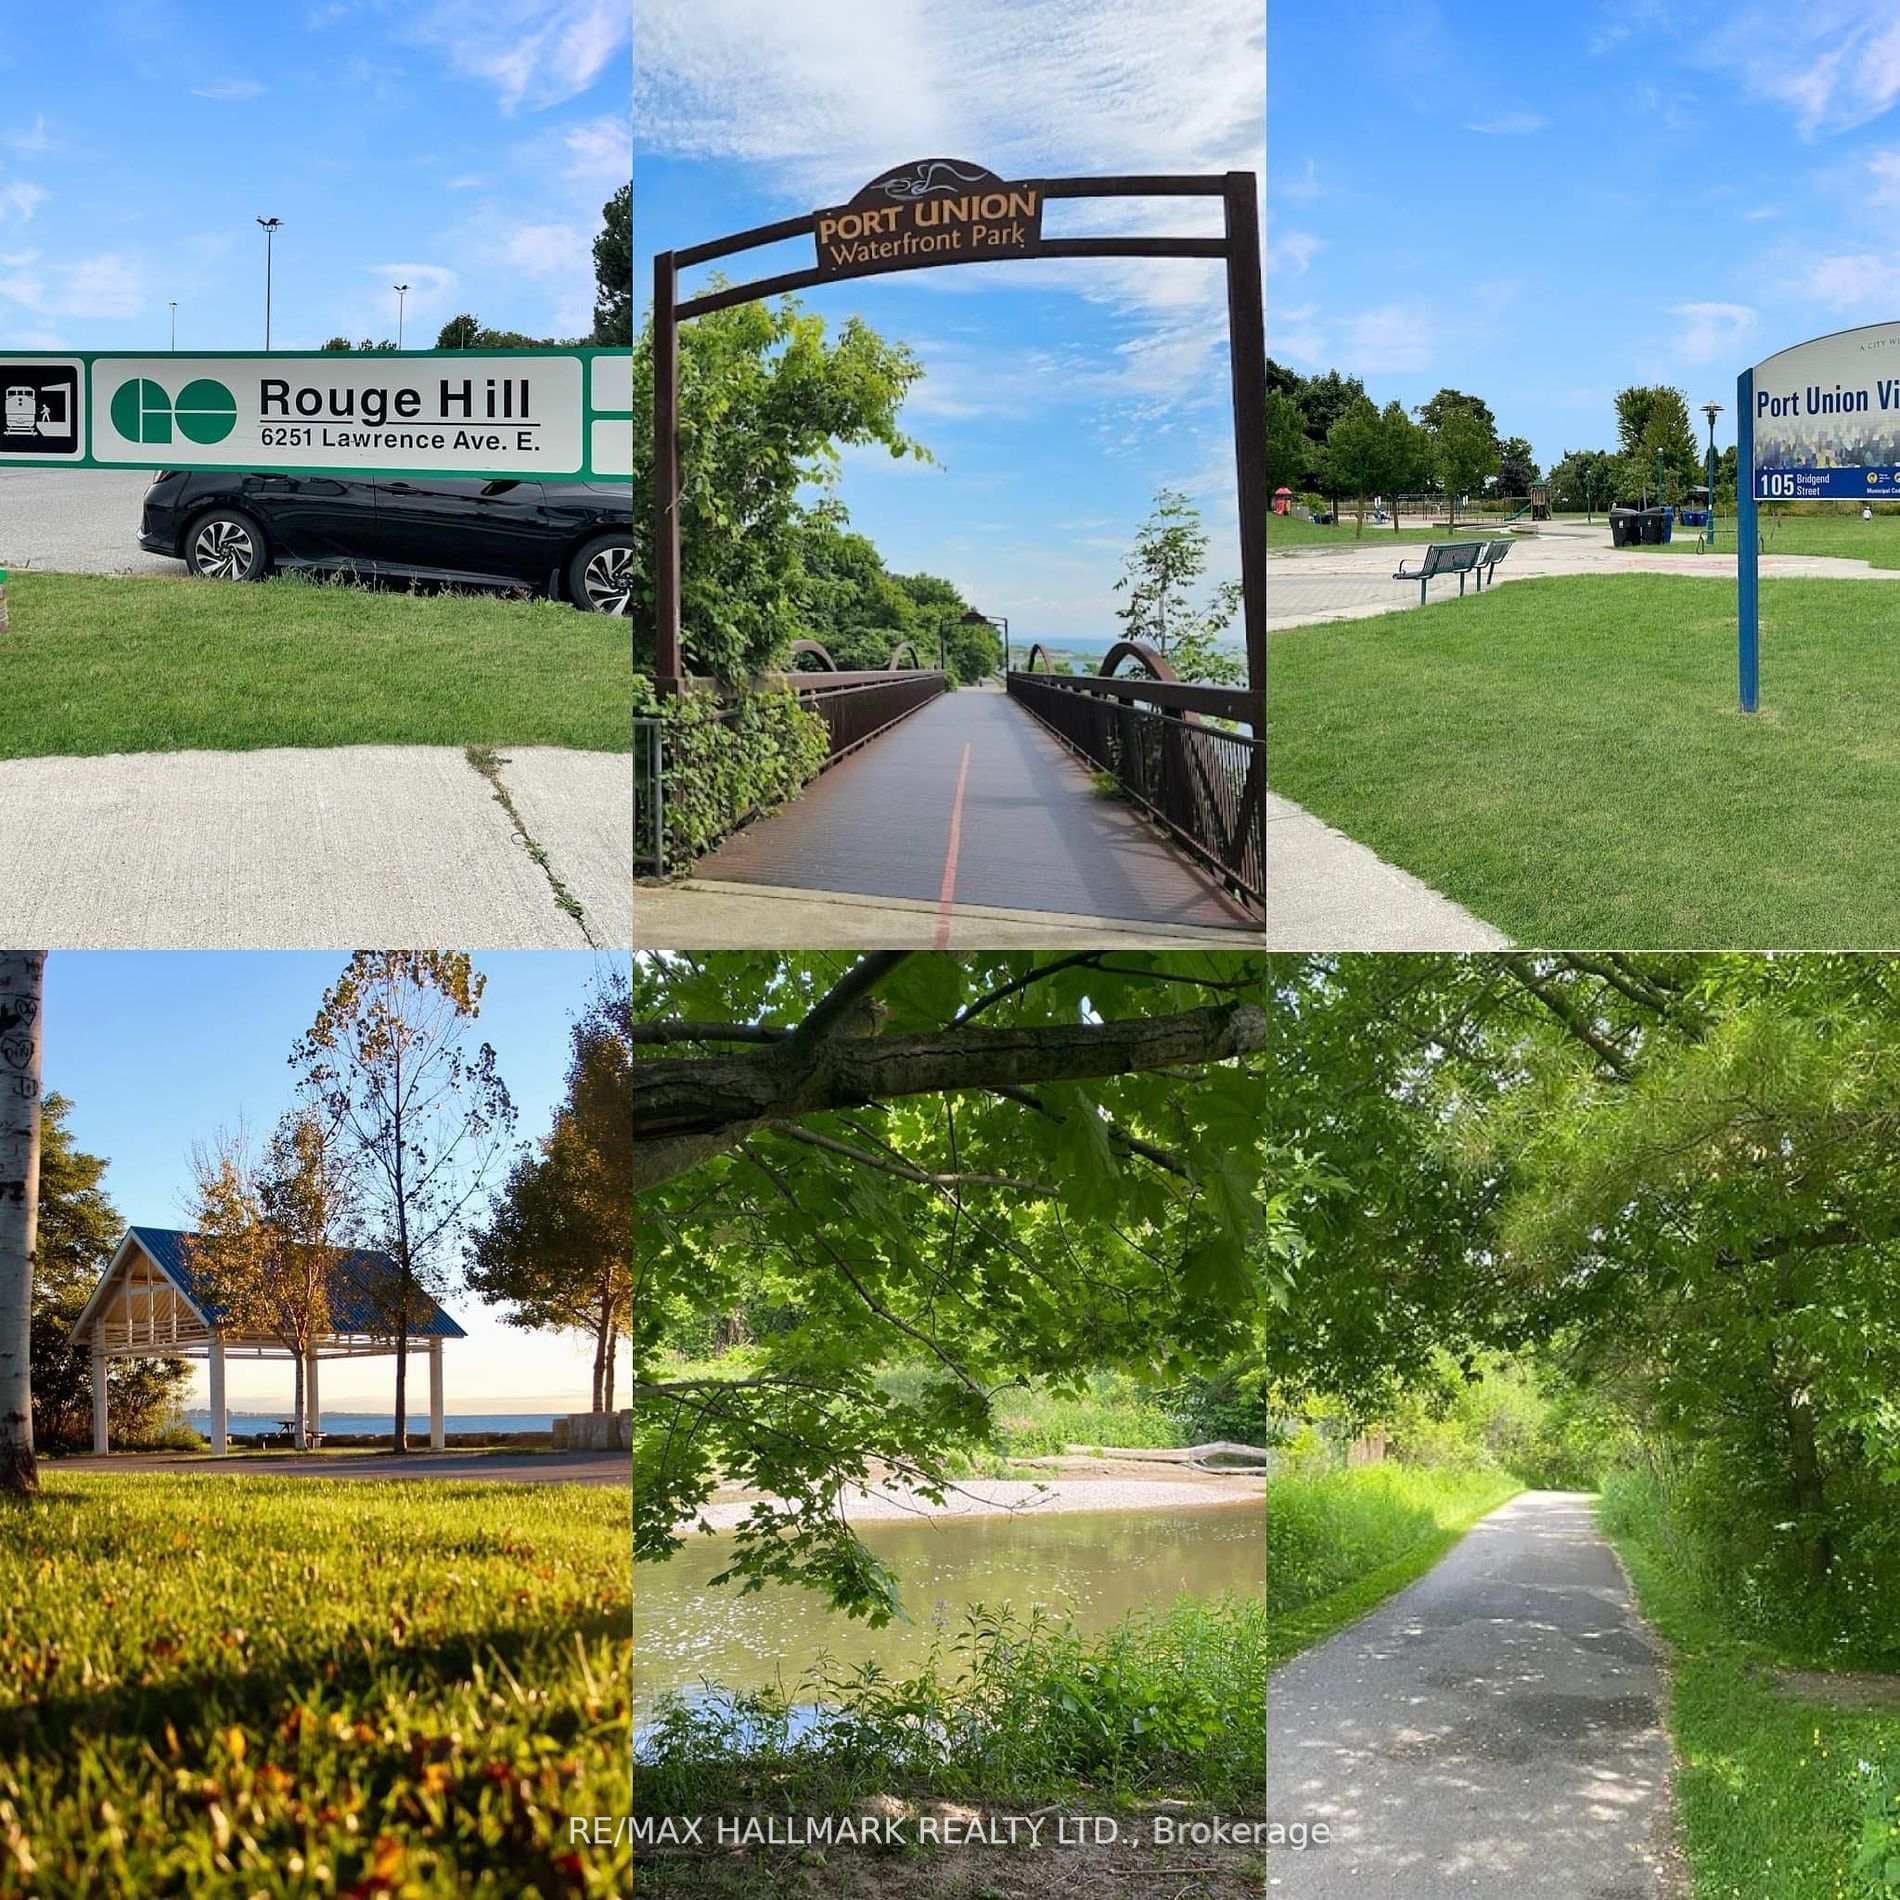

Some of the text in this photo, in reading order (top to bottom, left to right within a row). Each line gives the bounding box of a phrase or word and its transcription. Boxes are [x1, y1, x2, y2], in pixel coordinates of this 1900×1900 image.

[820, 191, 1036, 244] PORT UNION
[831, 222, 1025, 265] Waterfront Park
[260, 379, 530, 427] Rouge Hill
[1757, 391, 1799, 418] Port
[1807, 385, 1868, 414] Union
[261, 428, 541, 451] 6251 Lawrence Ave. E.
[1761, 474, 1829, 495] 105 Bridgend
[1797, 486, 1820, 495] Street
